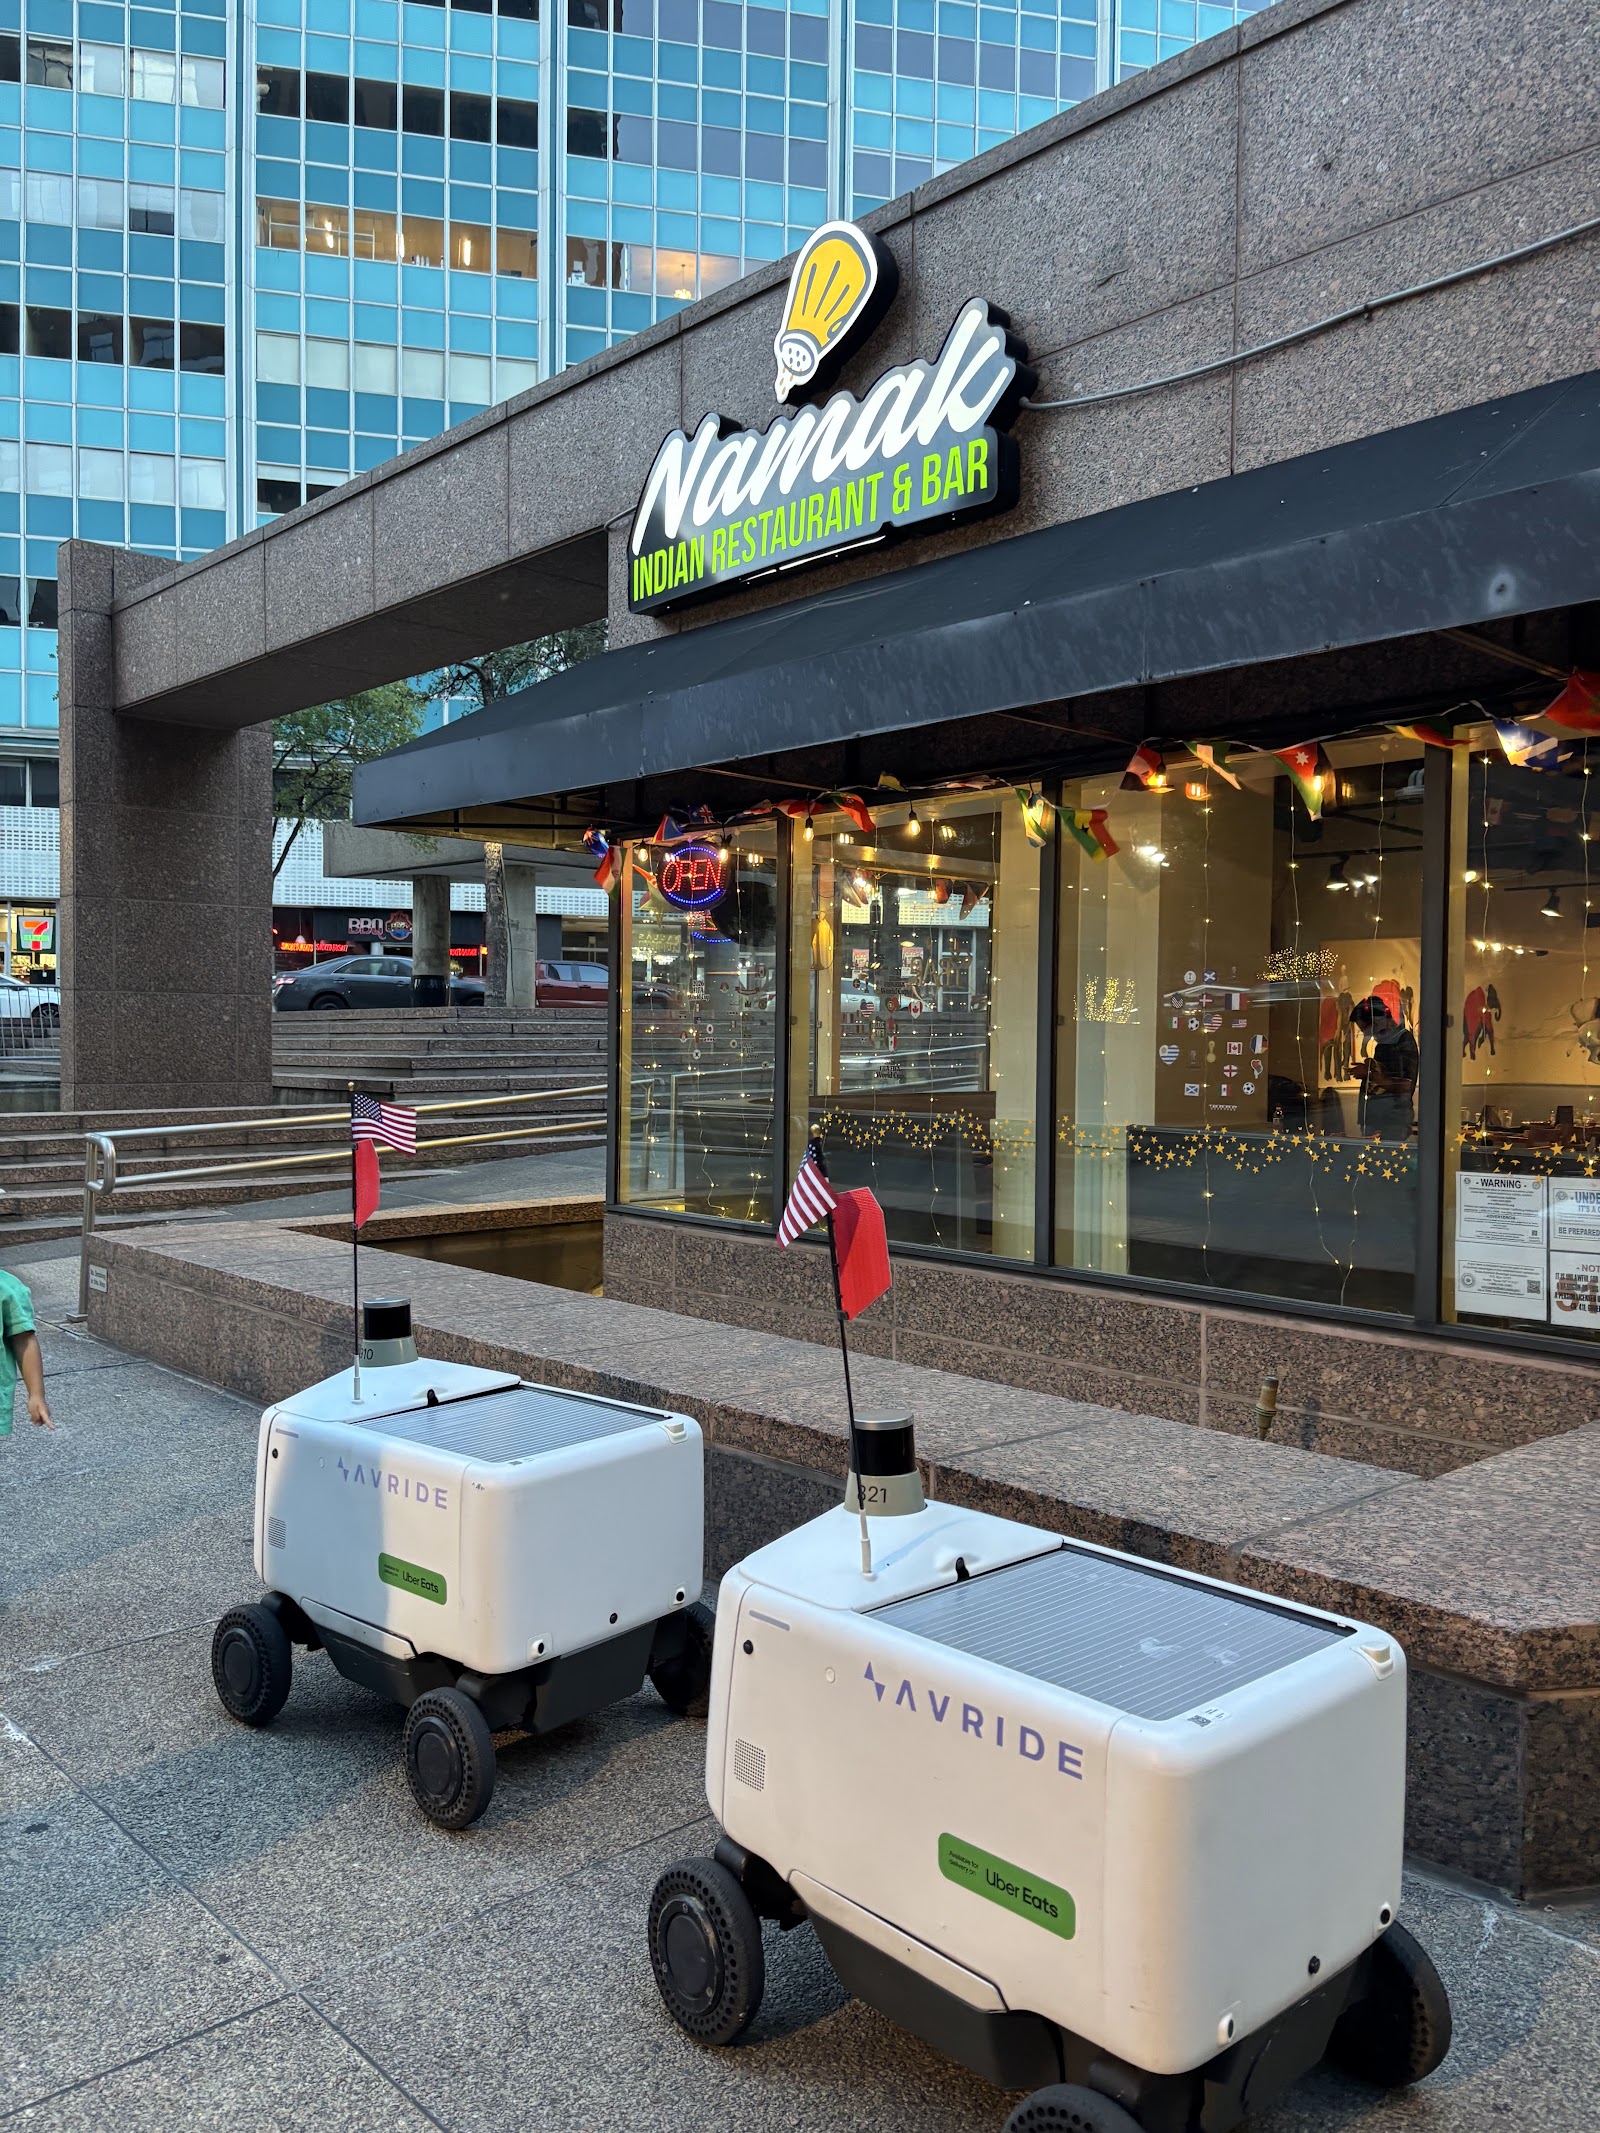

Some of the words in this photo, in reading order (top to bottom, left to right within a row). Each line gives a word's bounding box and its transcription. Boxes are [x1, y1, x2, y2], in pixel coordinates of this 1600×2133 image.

[632, 308, 1010, 555] Namak
[633, 535, 705, 602] INDIAN
[711, 471, 883, 574] RESTAURANT
[892, 462, 913, 514] &
[921, 438, 989, 506] BAR
[661, 858, 722, 893] OPEN
[348, 917, 387, 941] BBQ
[1480, 1178, 1522, 1189] WARNING
[354, 1463, 449, 1510] AVRIDE
[402, 1570, 420, 1585] Uber
[420, 1578, 439, 1594] Eats
[896, 1679, 1084, 1780] AVRIDE
[986, 1868, 1020, 1898] Uber
[1022, 1887, 1059, 1919] Eats
